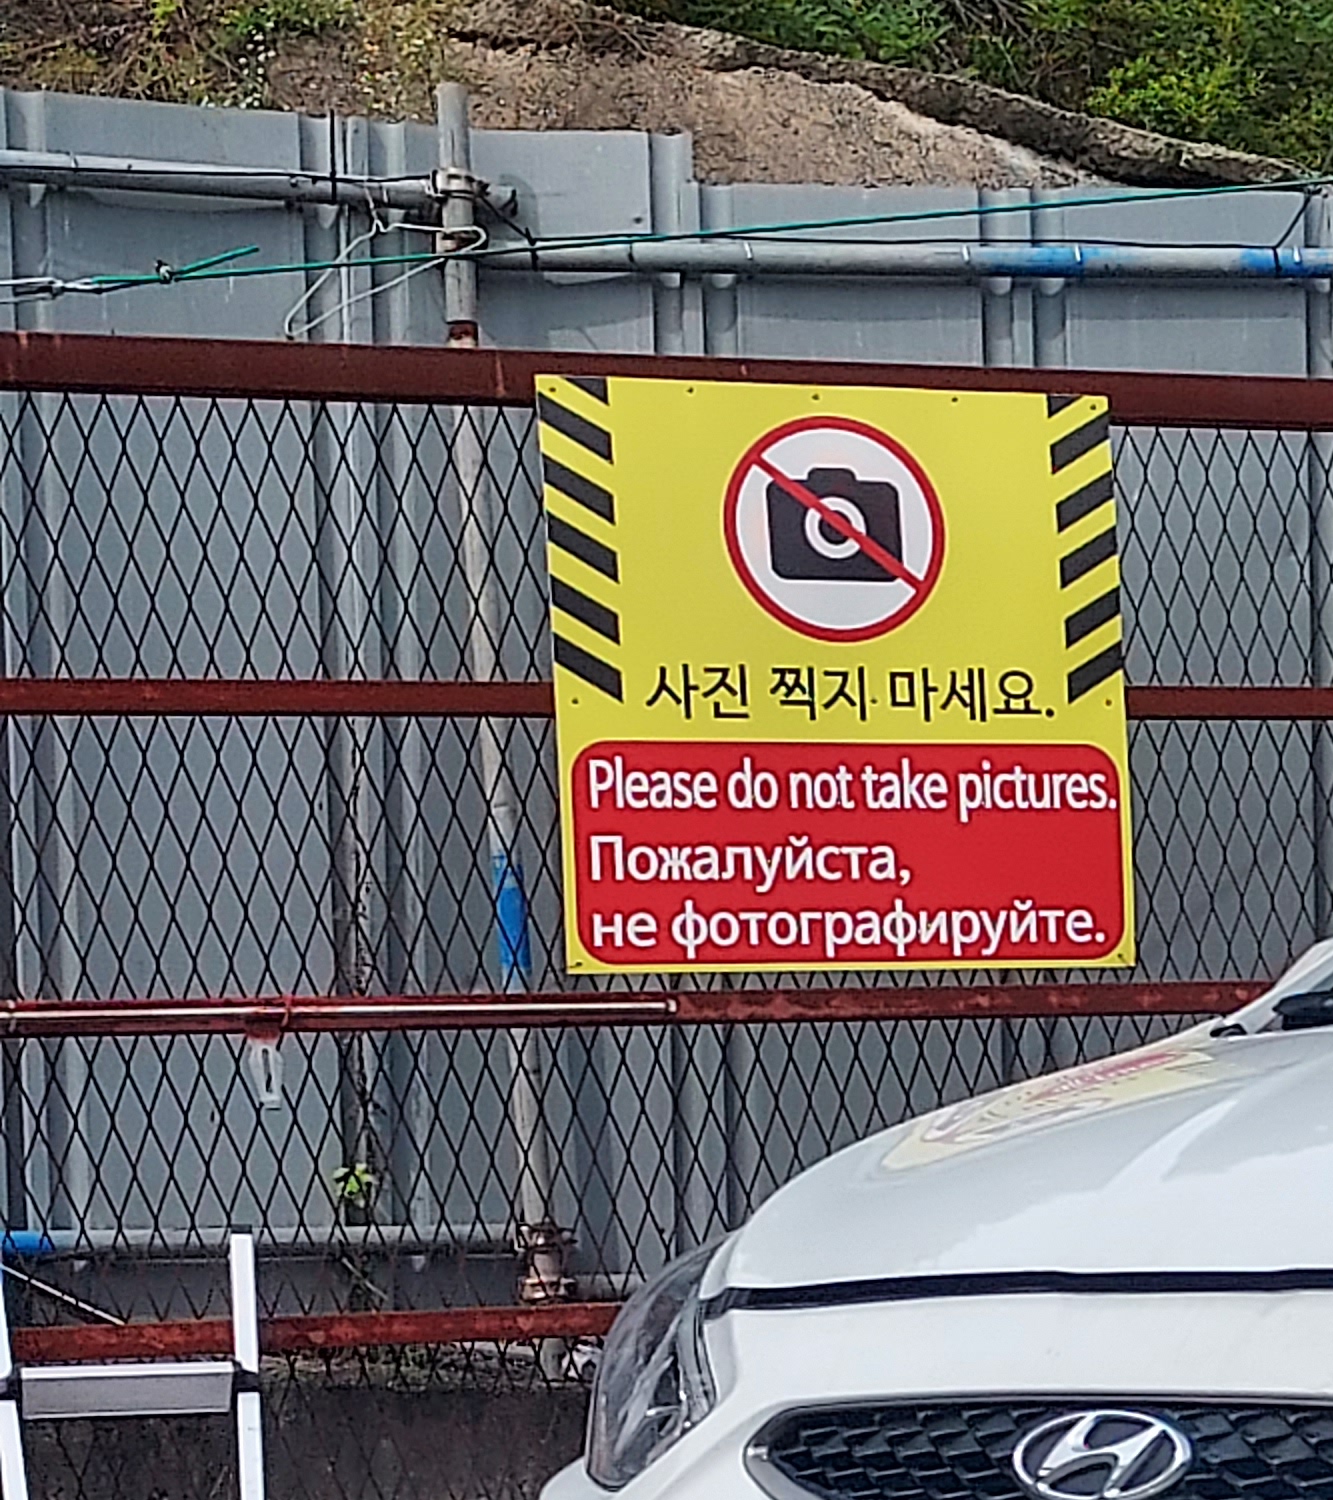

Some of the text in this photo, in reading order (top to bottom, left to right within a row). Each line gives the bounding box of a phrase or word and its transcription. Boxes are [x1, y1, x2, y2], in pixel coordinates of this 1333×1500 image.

[645, 664, 1055, 723] 사진 찍지 마세요.
[589, 756, 1117, 823] Please do not take pictures.
[590, 836, 911, 893] Пожалуйста,
[593, 899, 1105, 960] не фотографируйте.
